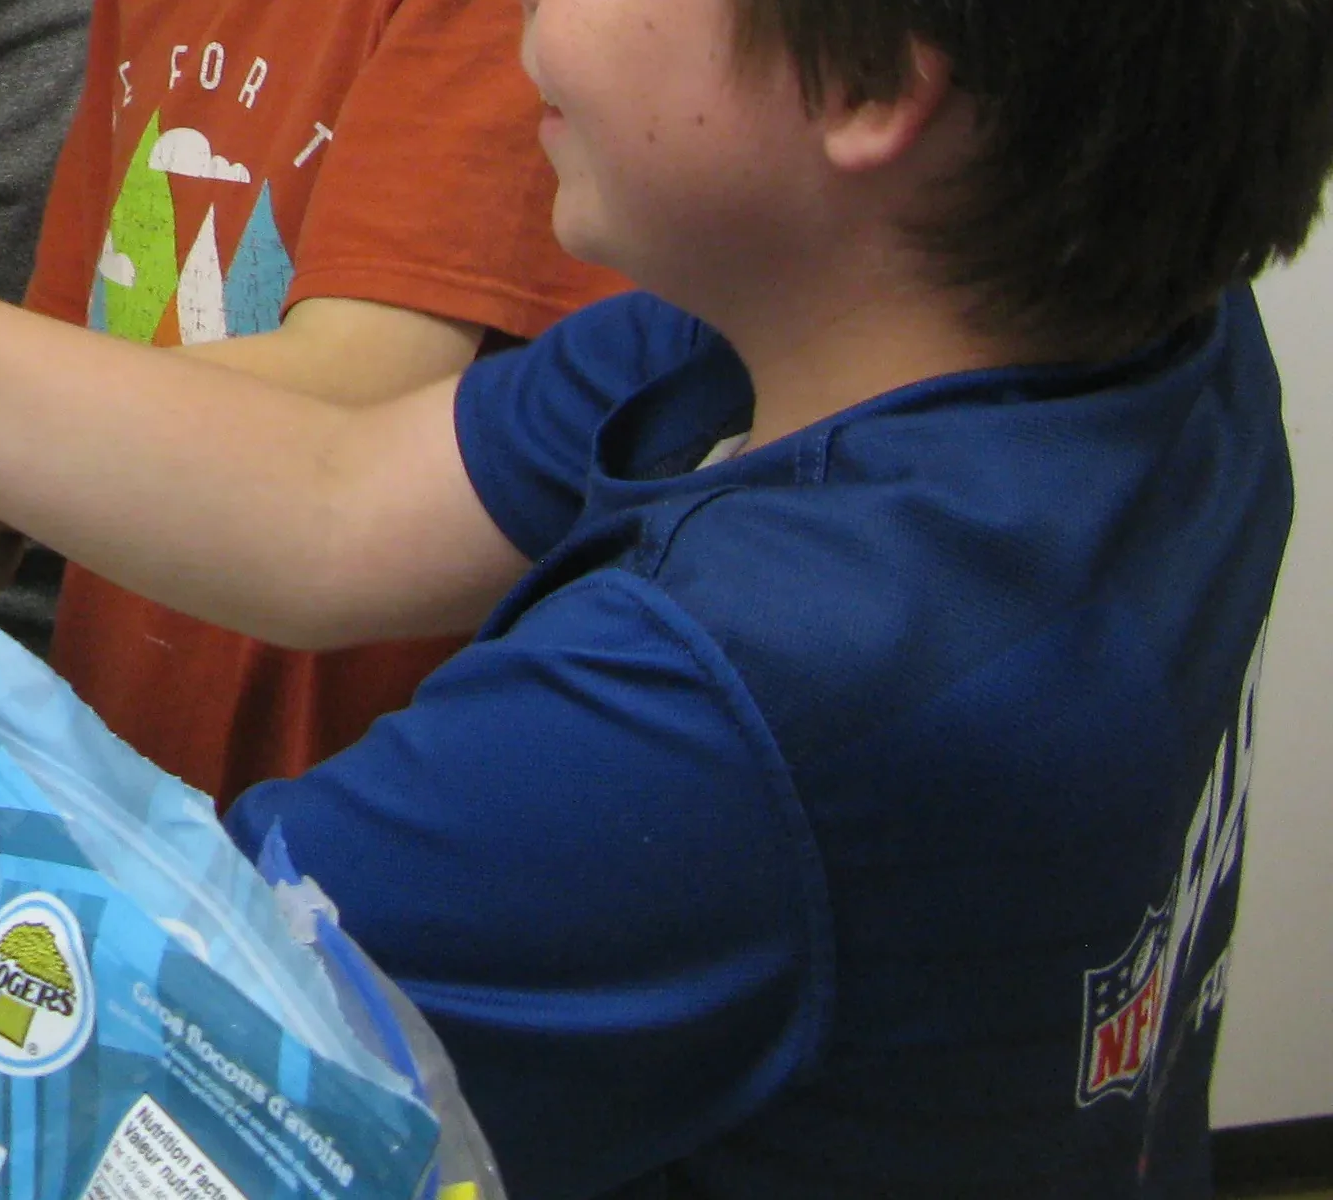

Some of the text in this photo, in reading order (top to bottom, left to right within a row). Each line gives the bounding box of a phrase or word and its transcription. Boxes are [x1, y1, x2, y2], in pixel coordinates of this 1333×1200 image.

[168, 41, 268, 109] FOR
[1089, 960, 1165, 1092] NF
[119, 1121, 167, 1168] Valeur
[132, 1105, 196, 1169] Nutrition
